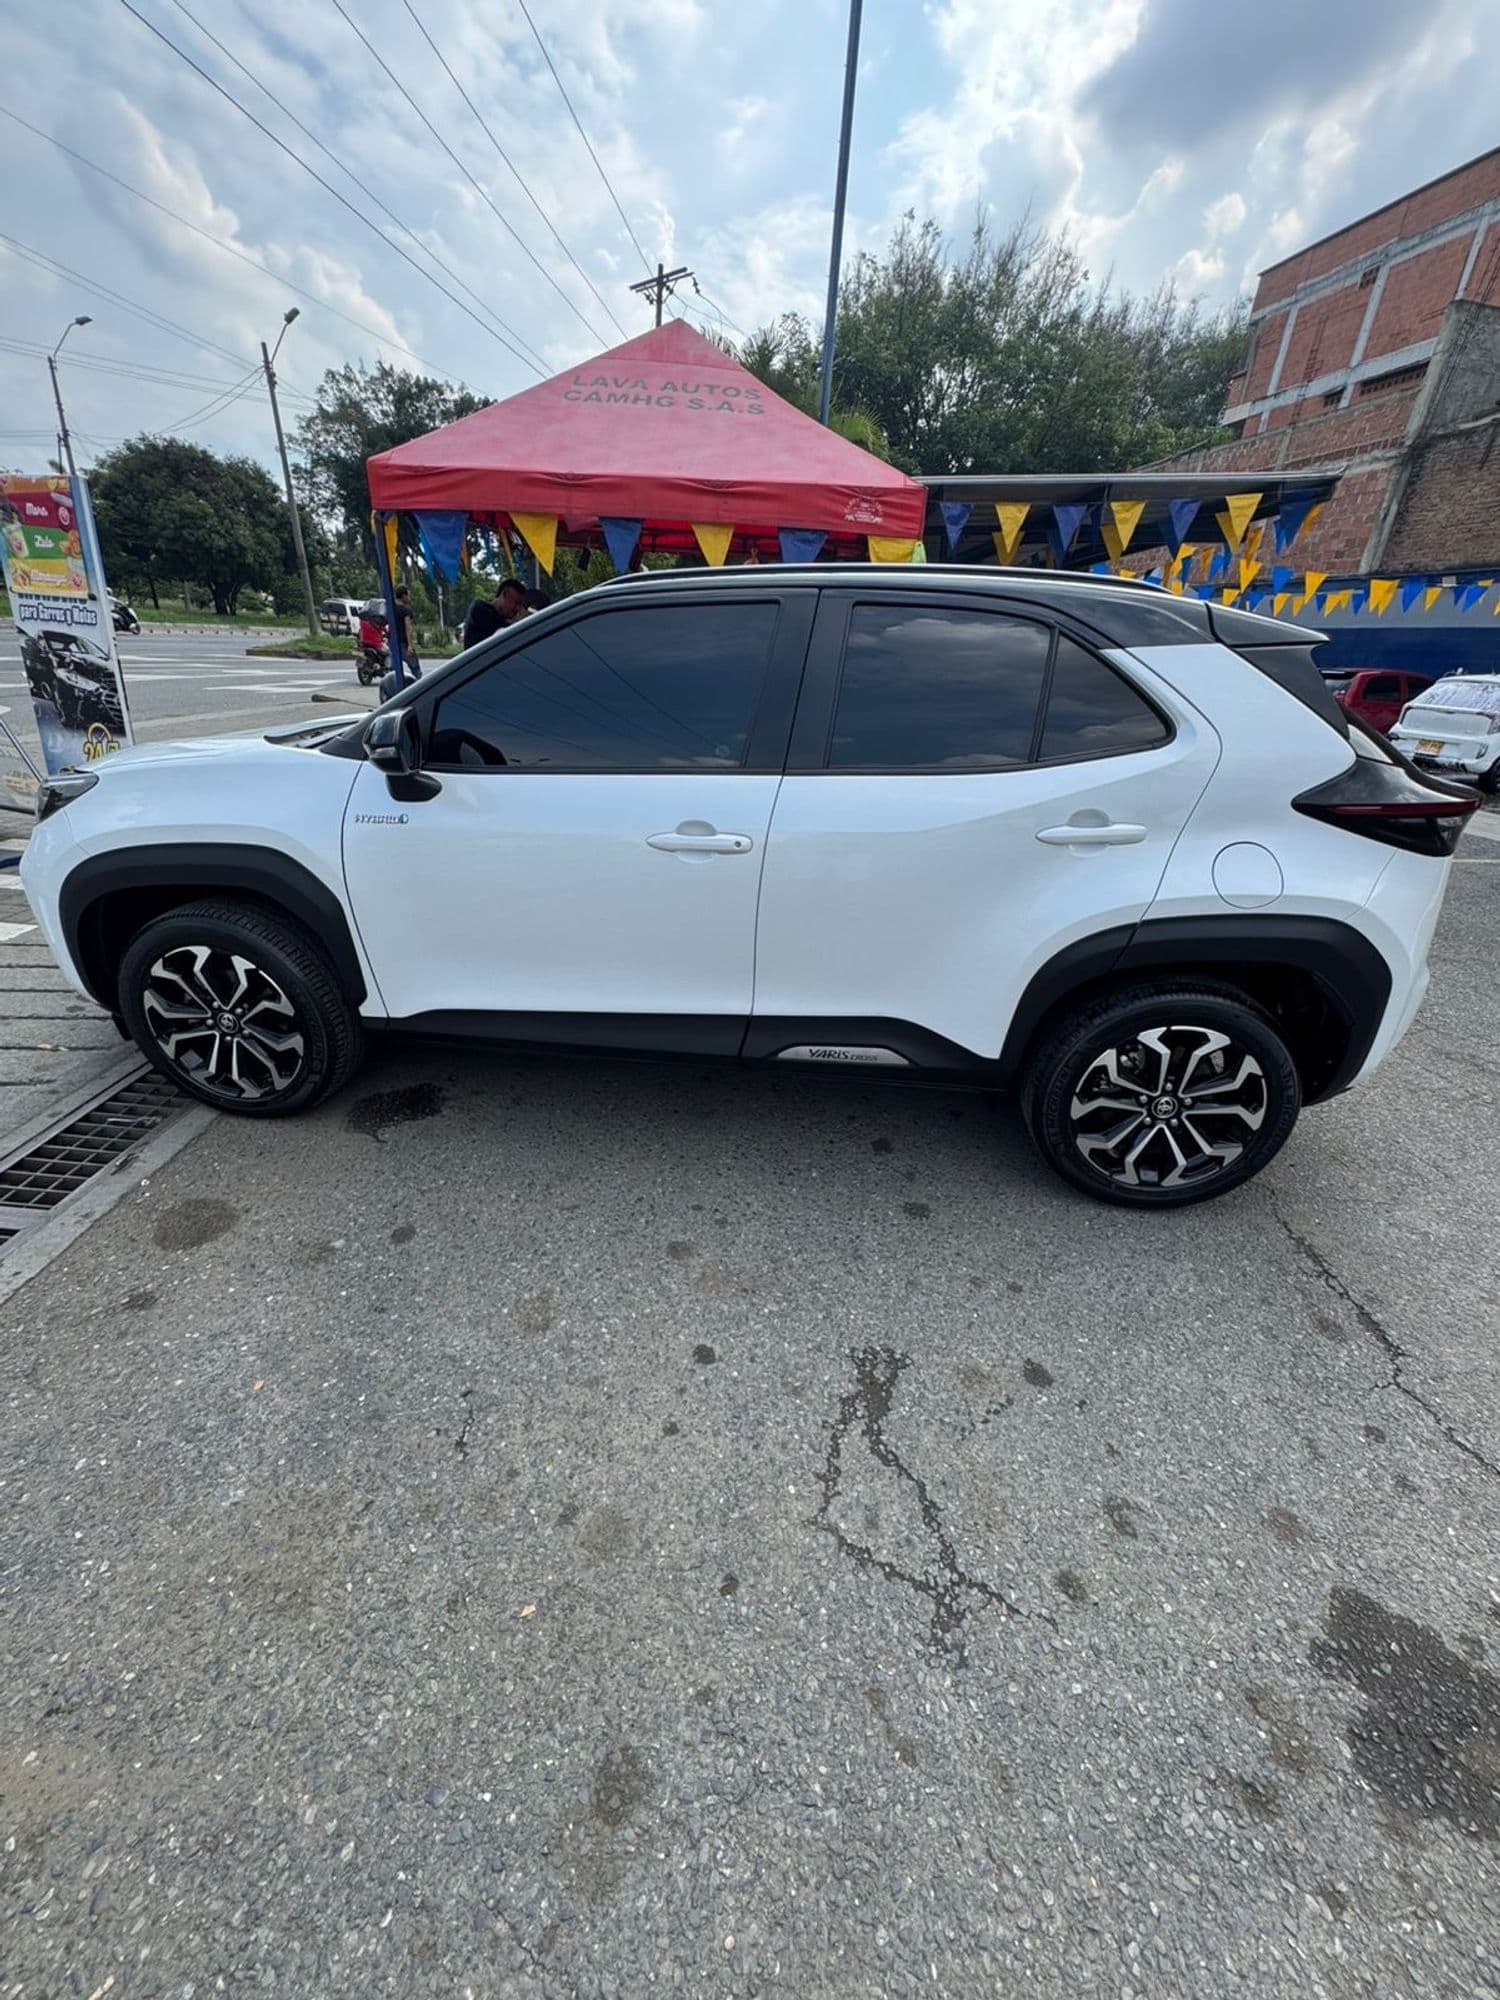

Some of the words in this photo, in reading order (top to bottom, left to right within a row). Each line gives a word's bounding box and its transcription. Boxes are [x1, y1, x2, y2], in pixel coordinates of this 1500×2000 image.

[572, 375, 648, 390] LAVA
[659, 380, 761, 400] AUTOS
[563, 390, 675, 408] CAMHG
[687, 398, 765, 415] S.A.S
[19, 604, 37, 621] para
[38, 602, 65, 622] Carros
[65, 608, 72, 625] y
[72, 605, 97, 625] Motos
